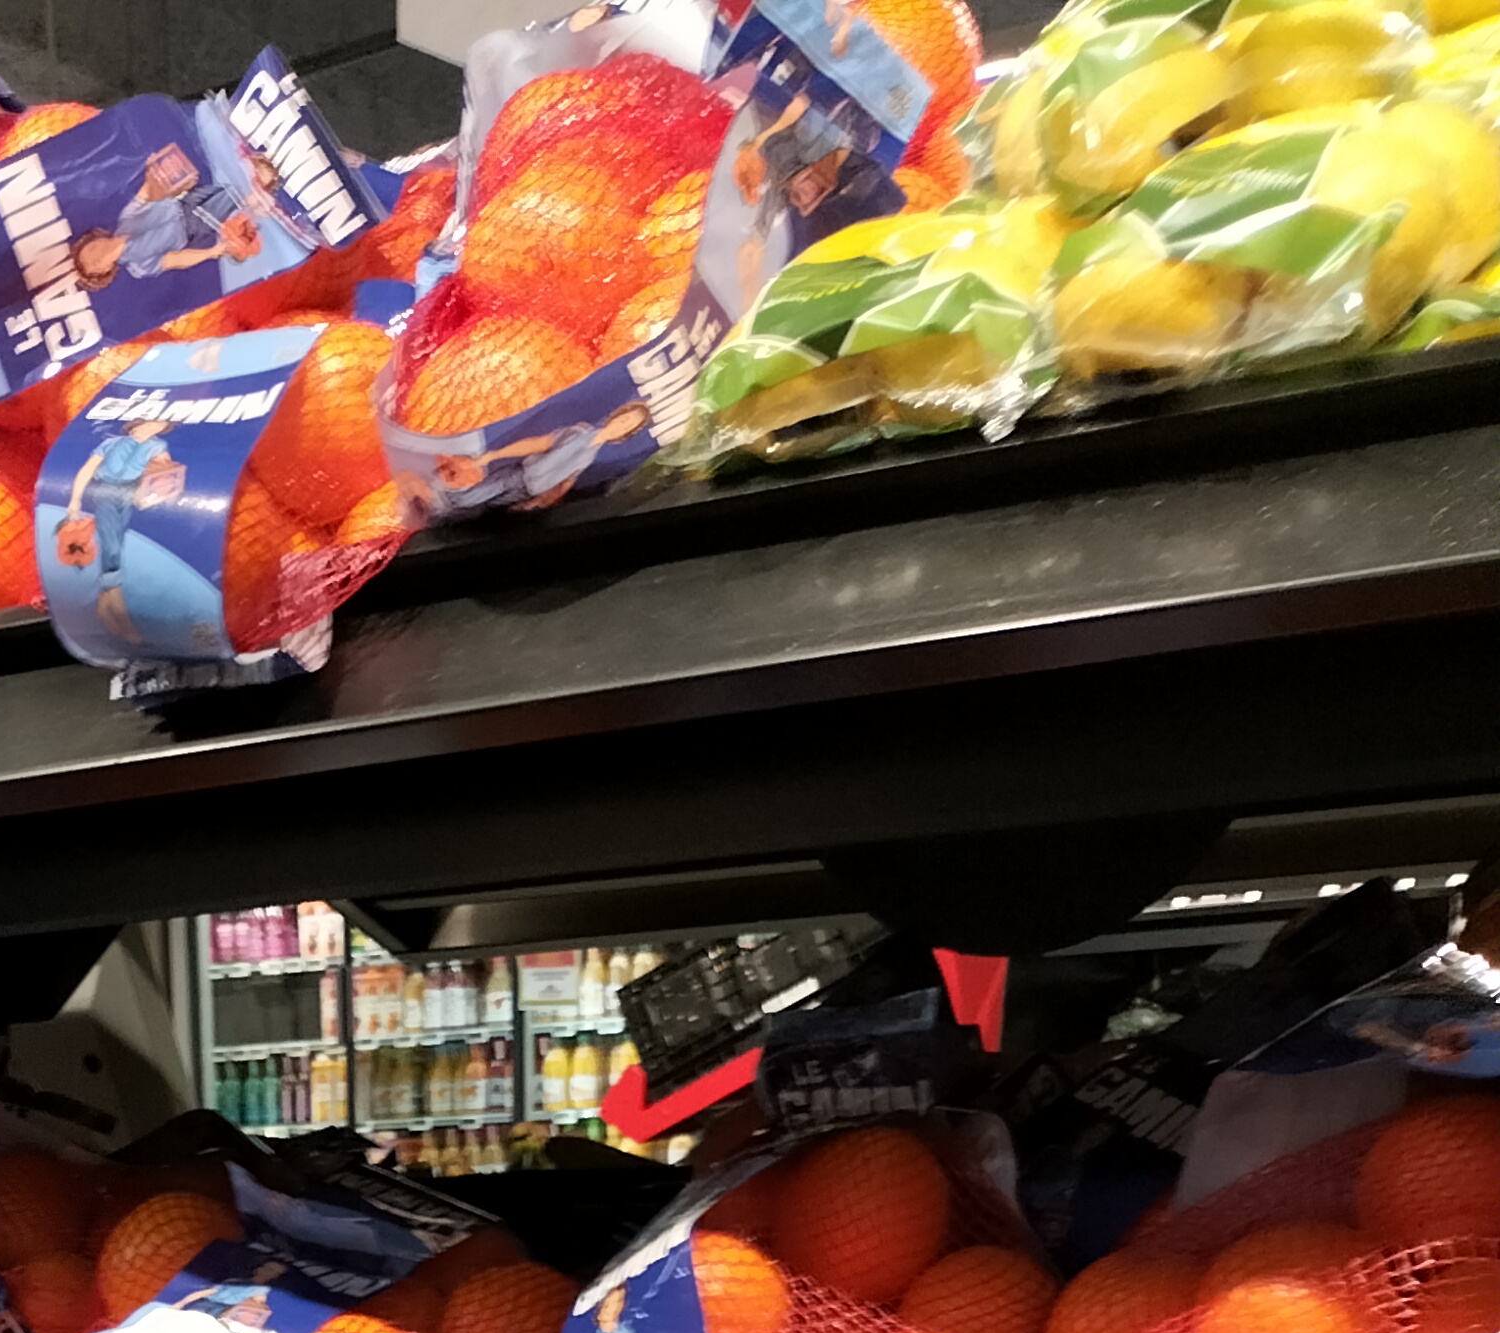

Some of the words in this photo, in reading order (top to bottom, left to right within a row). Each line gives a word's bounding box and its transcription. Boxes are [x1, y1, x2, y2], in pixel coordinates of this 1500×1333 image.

[229, 70, 368, 246] GAMIN
[4, 308, 44, 355] LE
[85, 381, 286, 424] GAMIN
[130, 388, 172, 402] LE
